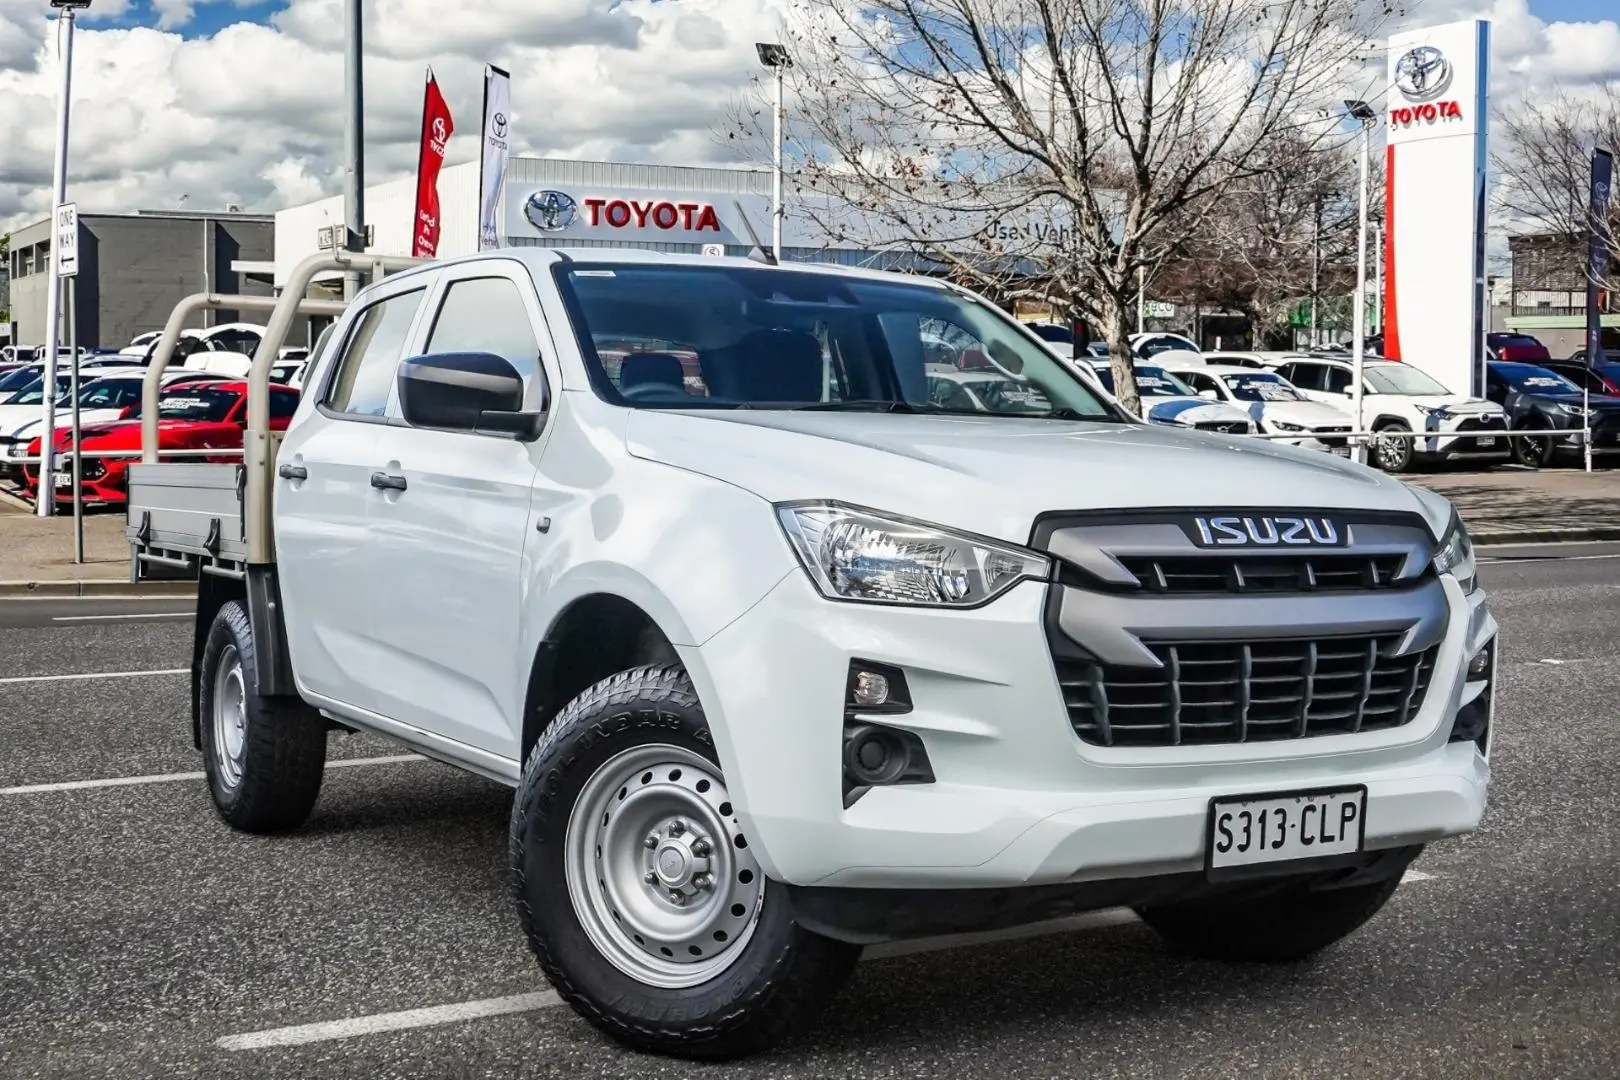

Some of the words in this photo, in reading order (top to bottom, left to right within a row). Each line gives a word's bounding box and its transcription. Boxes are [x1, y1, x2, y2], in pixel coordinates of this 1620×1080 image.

[1390, 100, 1462, 125] TOYOTA
[59, 210, 74, 227] ONE
[585, 198, 720, 232] TOYOTA
[59, 232, 75, 249] WAY
[1195, 517, 1337, 544] ISUZU
